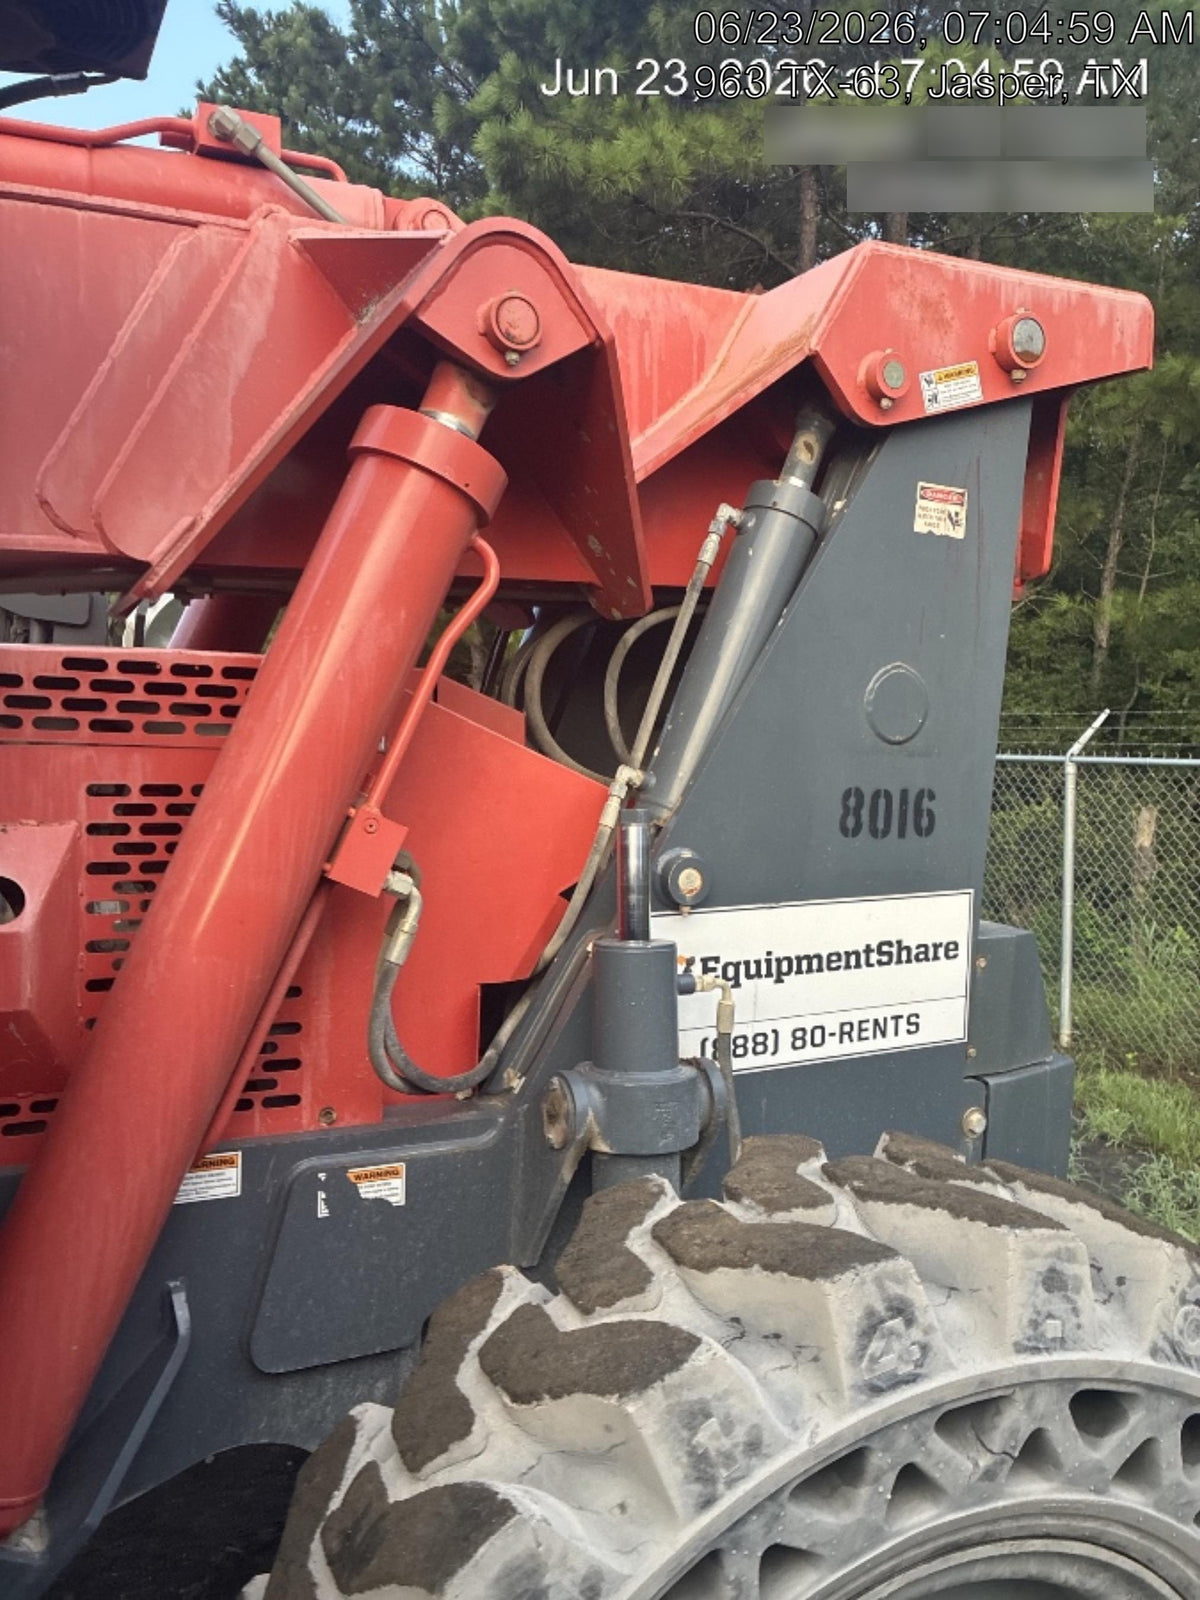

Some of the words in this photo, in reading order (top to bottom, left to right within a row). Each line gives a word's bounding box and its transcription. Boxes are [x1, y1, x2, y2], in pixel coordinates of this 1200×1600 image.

[838, 786, 936, 839] 8016
[700, 939, 960, 989] EquipmentShare
[791, 1013, 921, 1051] 80-RENTS
[353, 1169, 399, 1181] WARNING
